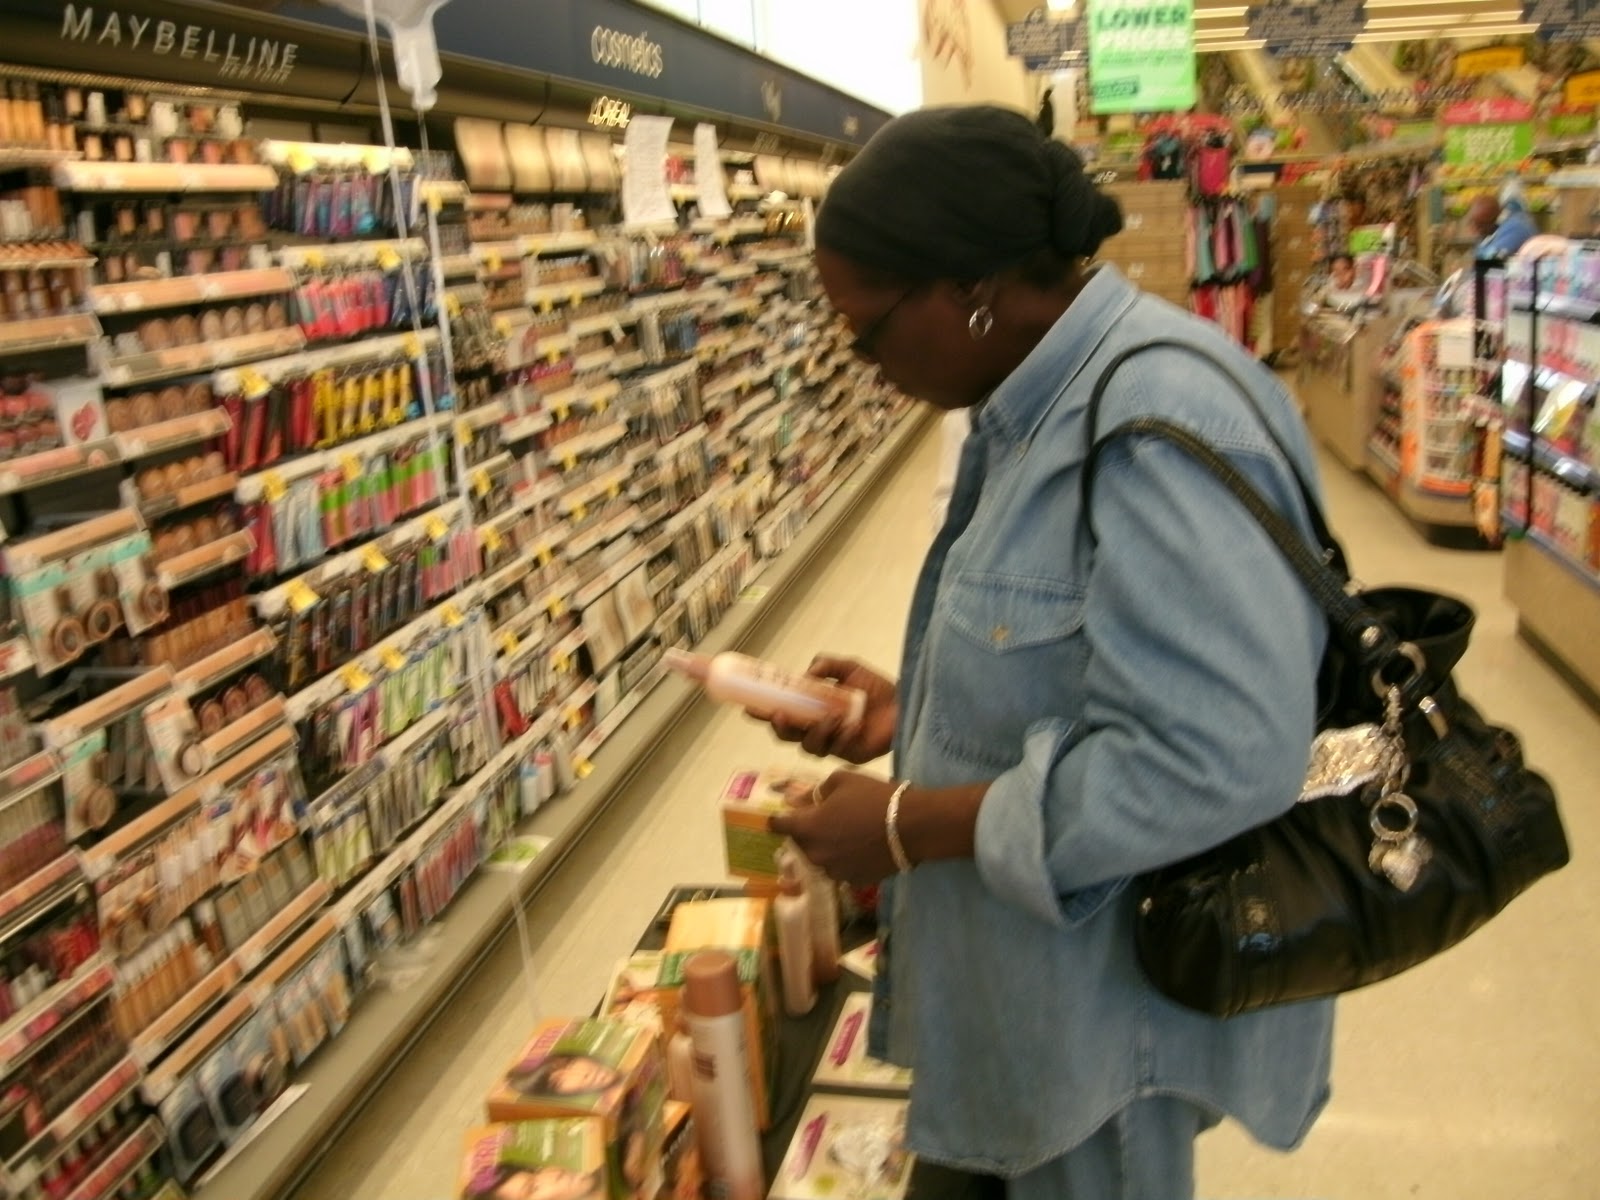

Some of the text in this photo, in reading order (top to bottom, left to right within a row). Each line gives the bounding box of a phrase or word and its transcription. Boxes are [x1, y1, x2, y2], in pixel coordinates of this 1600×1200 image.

[60, 3, 299, 72] MAYBELLINE
[1095, 7, 1186, 32] LOWER
[591, 25, 663, 79] cosmetics
